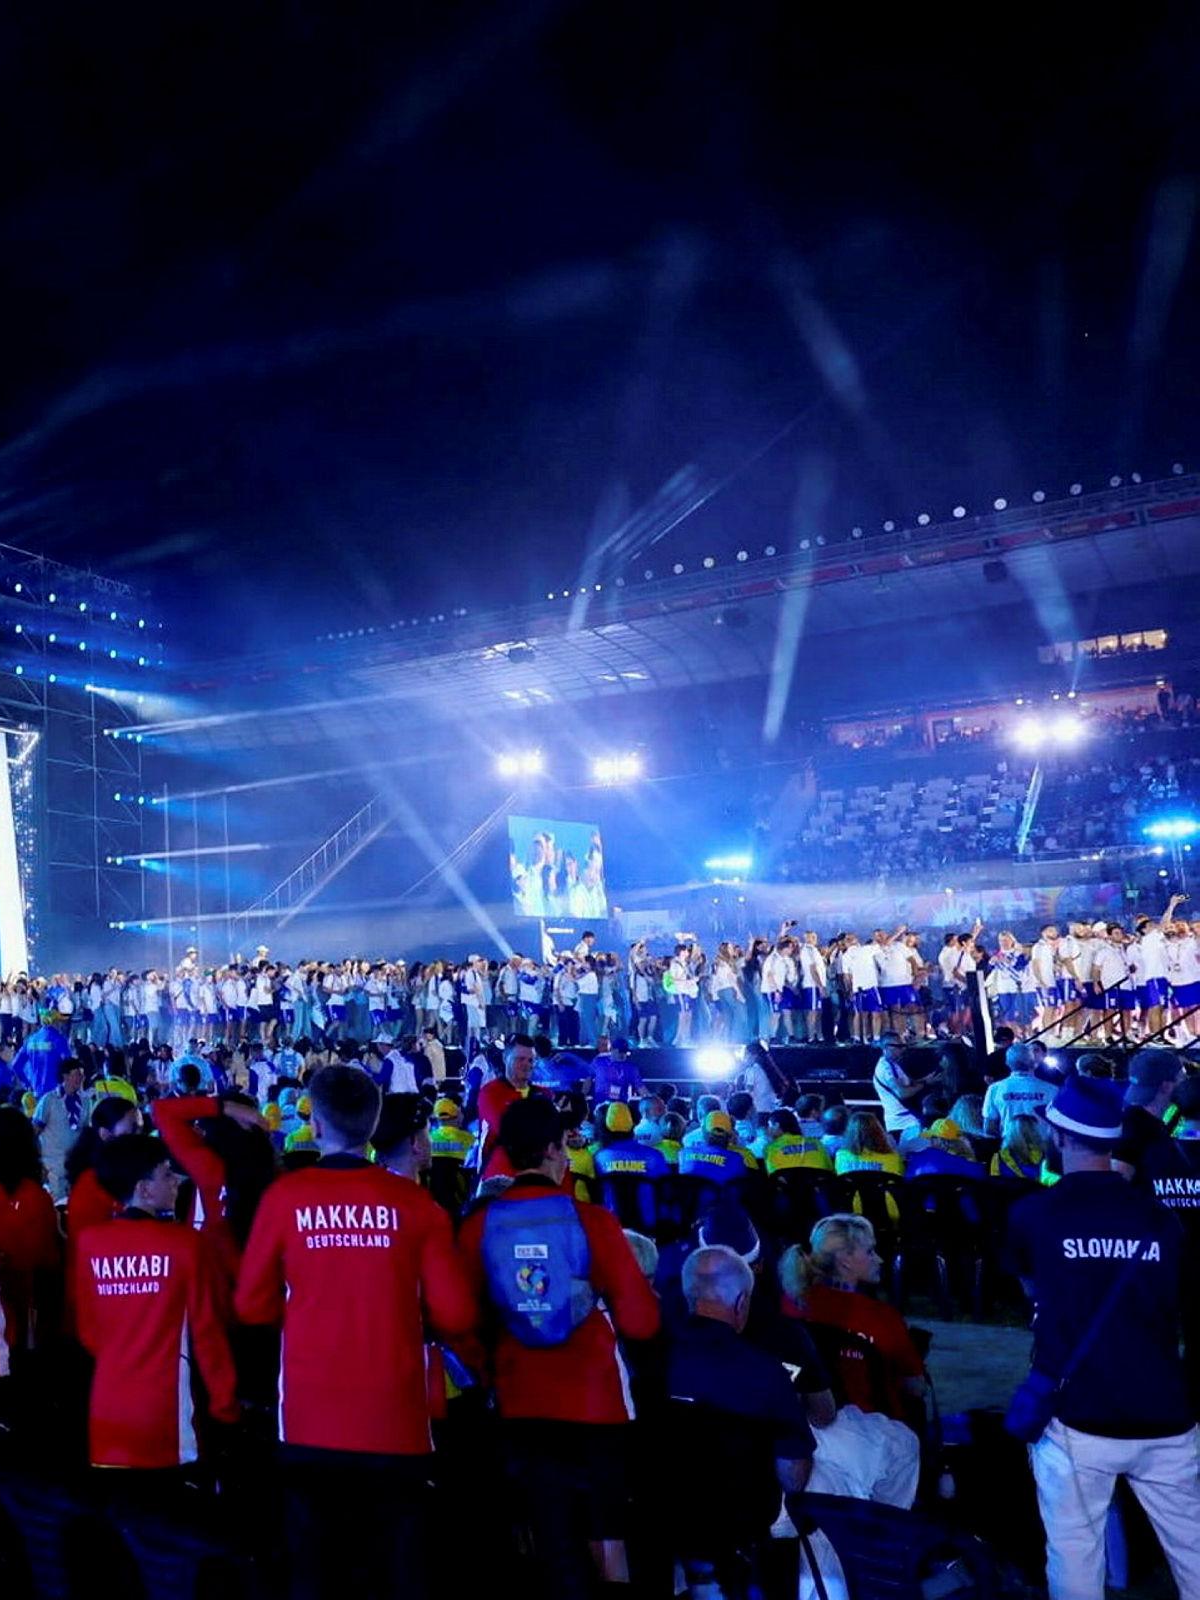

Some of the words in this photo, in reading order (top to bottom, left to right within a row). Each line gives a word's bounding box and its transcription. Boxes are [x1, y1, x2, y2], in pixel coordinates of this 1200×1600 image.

[295, 1204, 399, 1233] MAKKABI
[306, 1233, 391, 1249] DEUTSCHLAND
[90, 1254, 170, 1280] MAKKABI
[97, 1280, 161, 1296] DEUTSCHLAND
